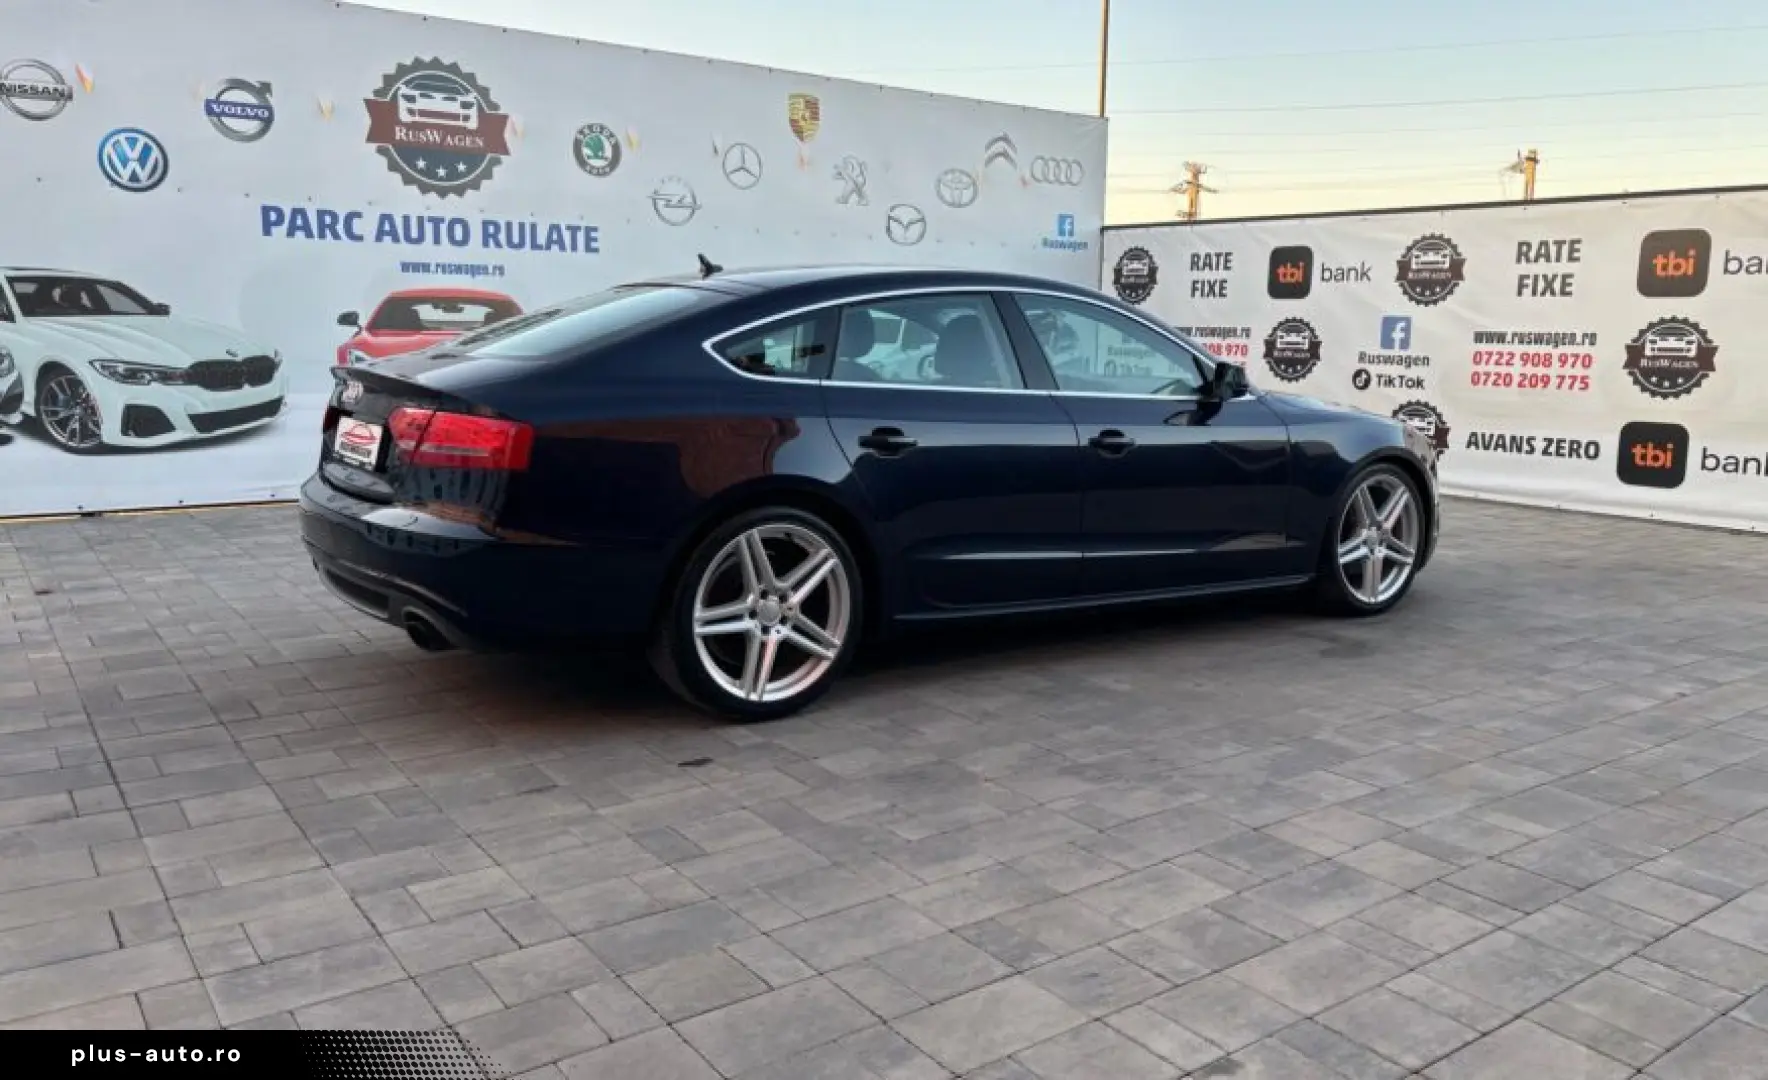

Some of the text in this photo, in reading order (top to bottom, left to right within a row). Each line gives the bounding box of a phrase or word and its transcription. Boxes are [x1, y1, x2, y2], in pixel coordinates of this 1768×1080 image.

[0, 82, 66, 98] NISSAN
[211, 102, 270, 118] VOLVO
[260, 204, 600, 253] PARC AUTO RULATE
[1042, 237, 1089, 252] Ruswagen
[1515, 239, 1583, 265] RATE
[400, 260, 505, 278] www.ruswagen.ro
[1190, 251, 1233, 271] RATE
[1652, 248, 1768, 276] tbi ba
[1276, 261, 1372, 283] tbi bank
[1190, 279, 1228, 299] FIXE
[1516, 273, 1574, 298] FIXE
[1473, 330, 1597, 348] www.ruswagen.ro
[1225, 343, 1248, 356] 970
[1358, 351, 1430, 369] Ruswagen
[1472, 351, 1593, 369] 0722 908 970
[1376, 373, 1424, 390] TikTok
[1471, 371, 1590, 391] 0720 209 775
[1465, 431, 1601, 460] AVANS ZERO
[1631, 442, 1674, 468] tbi
